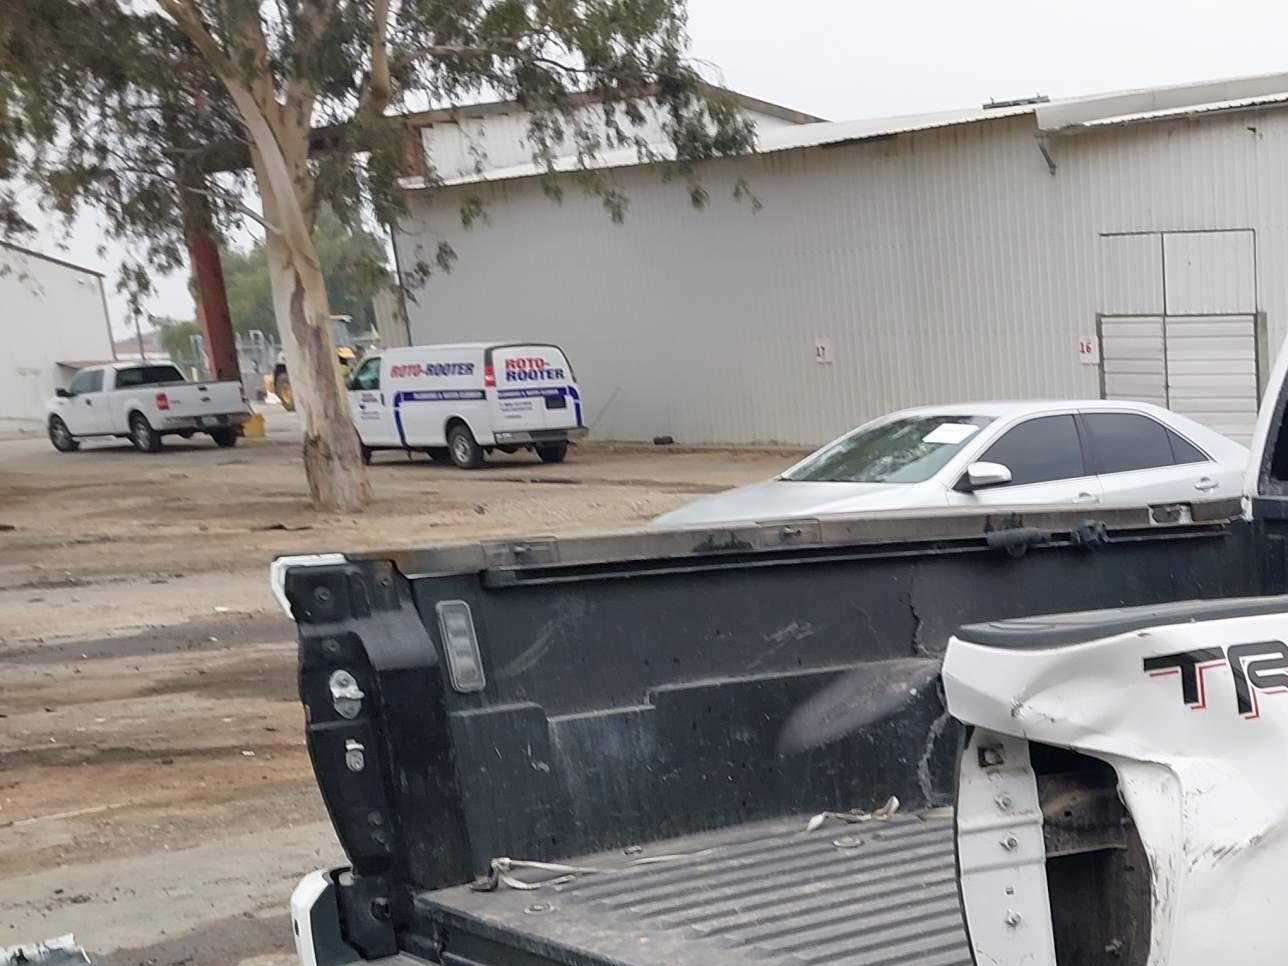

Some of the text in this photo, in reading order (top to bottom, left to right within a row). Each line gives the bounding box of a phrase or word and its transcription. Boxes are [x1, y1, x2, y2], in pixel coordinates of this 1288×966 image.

[390, 362, 475, 378] ROTO-ROOTER
[504, 357, 550, 370] ROTO-
[505, 367, 564, 382] ROOTER
